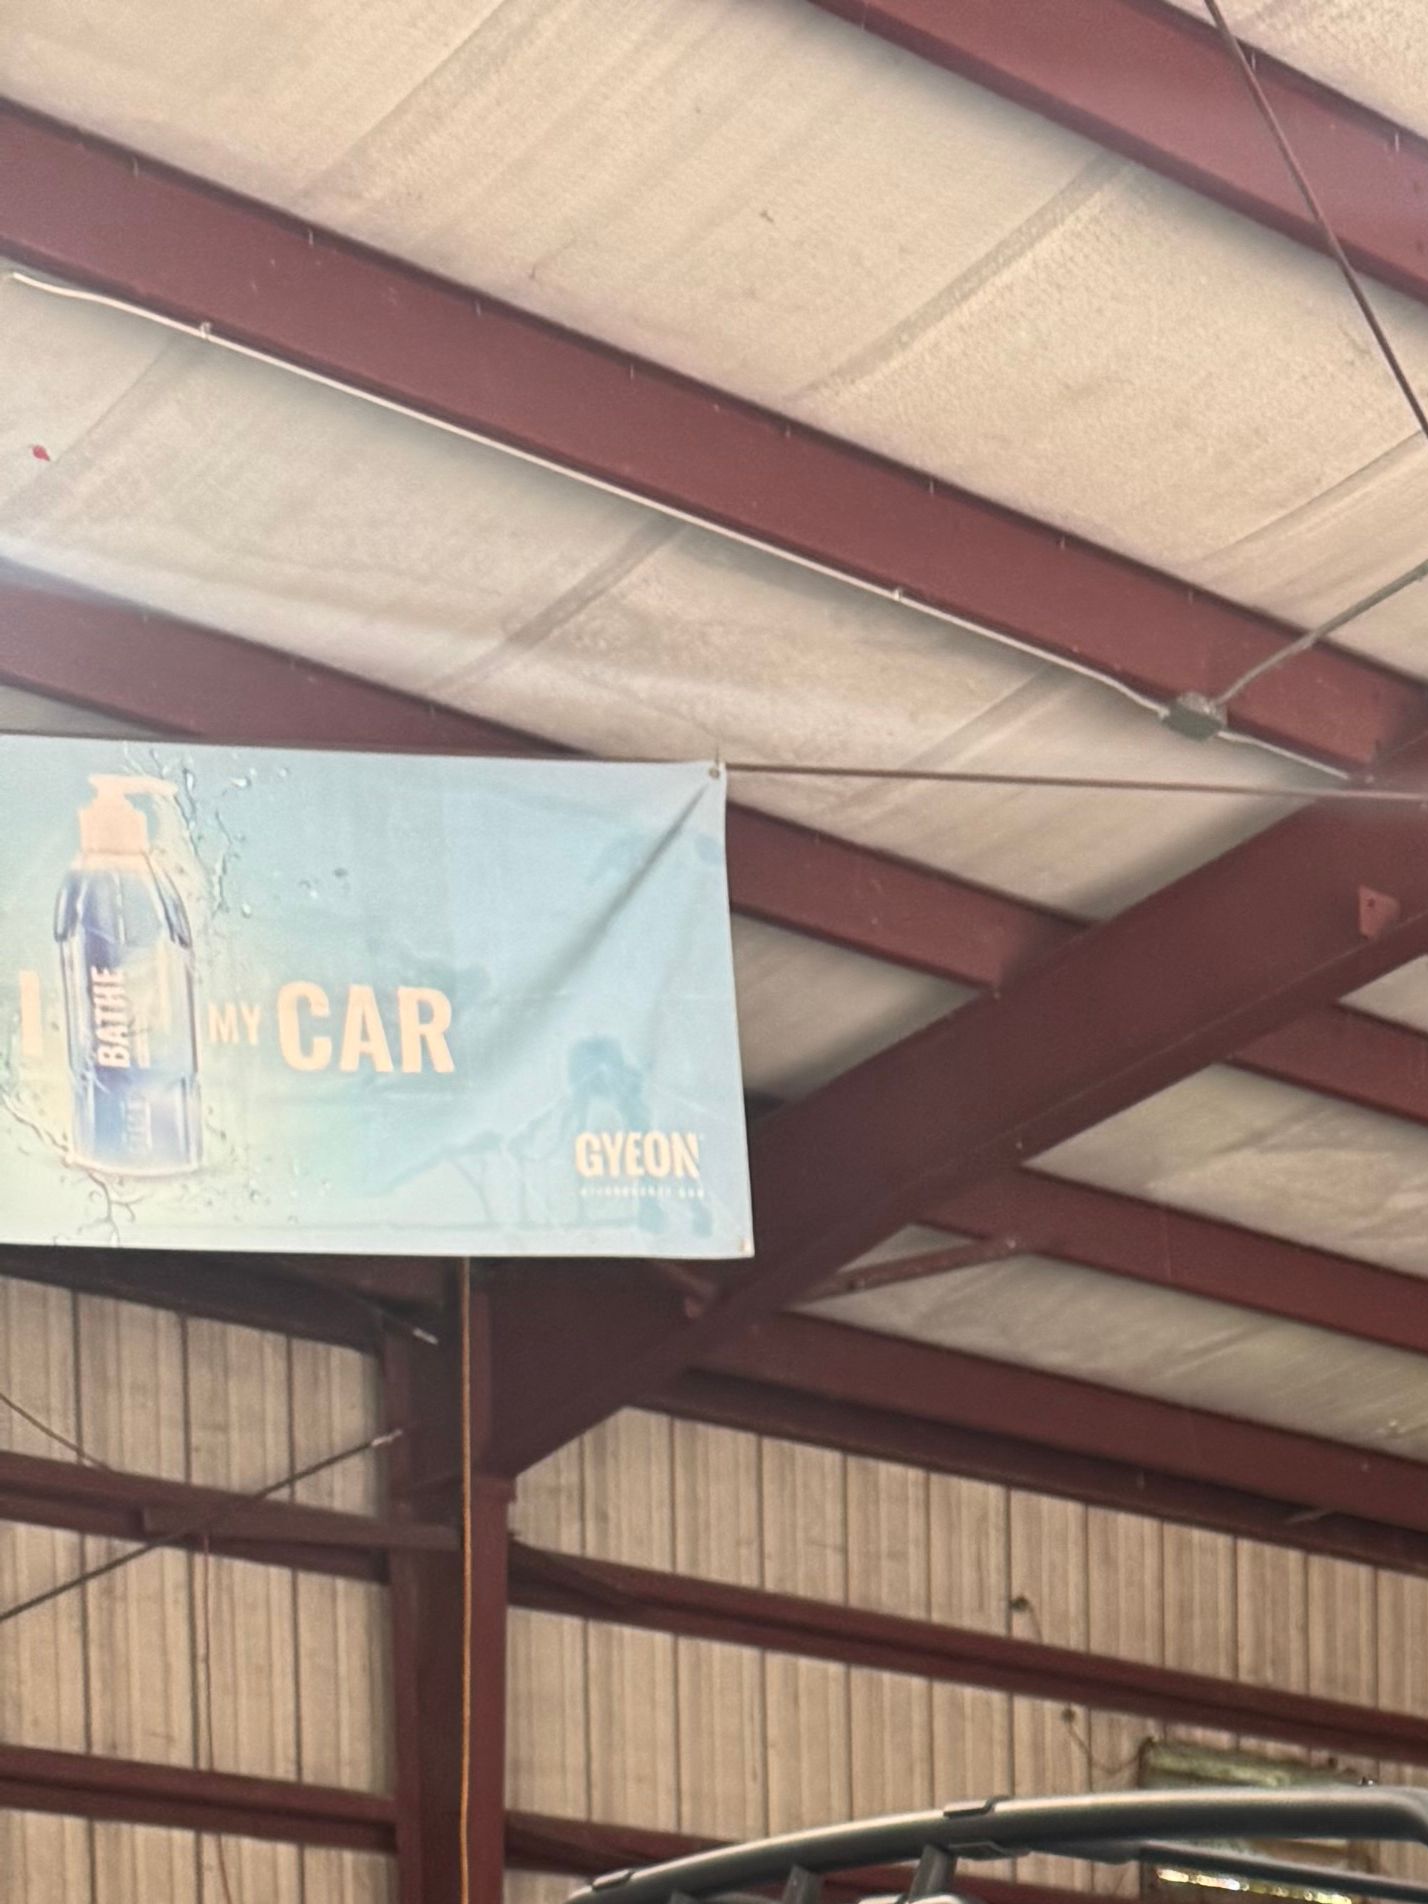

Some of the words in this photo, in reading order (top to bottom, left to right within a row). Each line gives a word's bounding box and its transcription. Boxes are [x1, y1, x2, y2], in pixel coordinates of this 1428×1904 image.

[207, 1001, 262, 1046] MY
[276, 980, 456, 1074] CAR
[575, 1130, 701, 1180] GYEON
